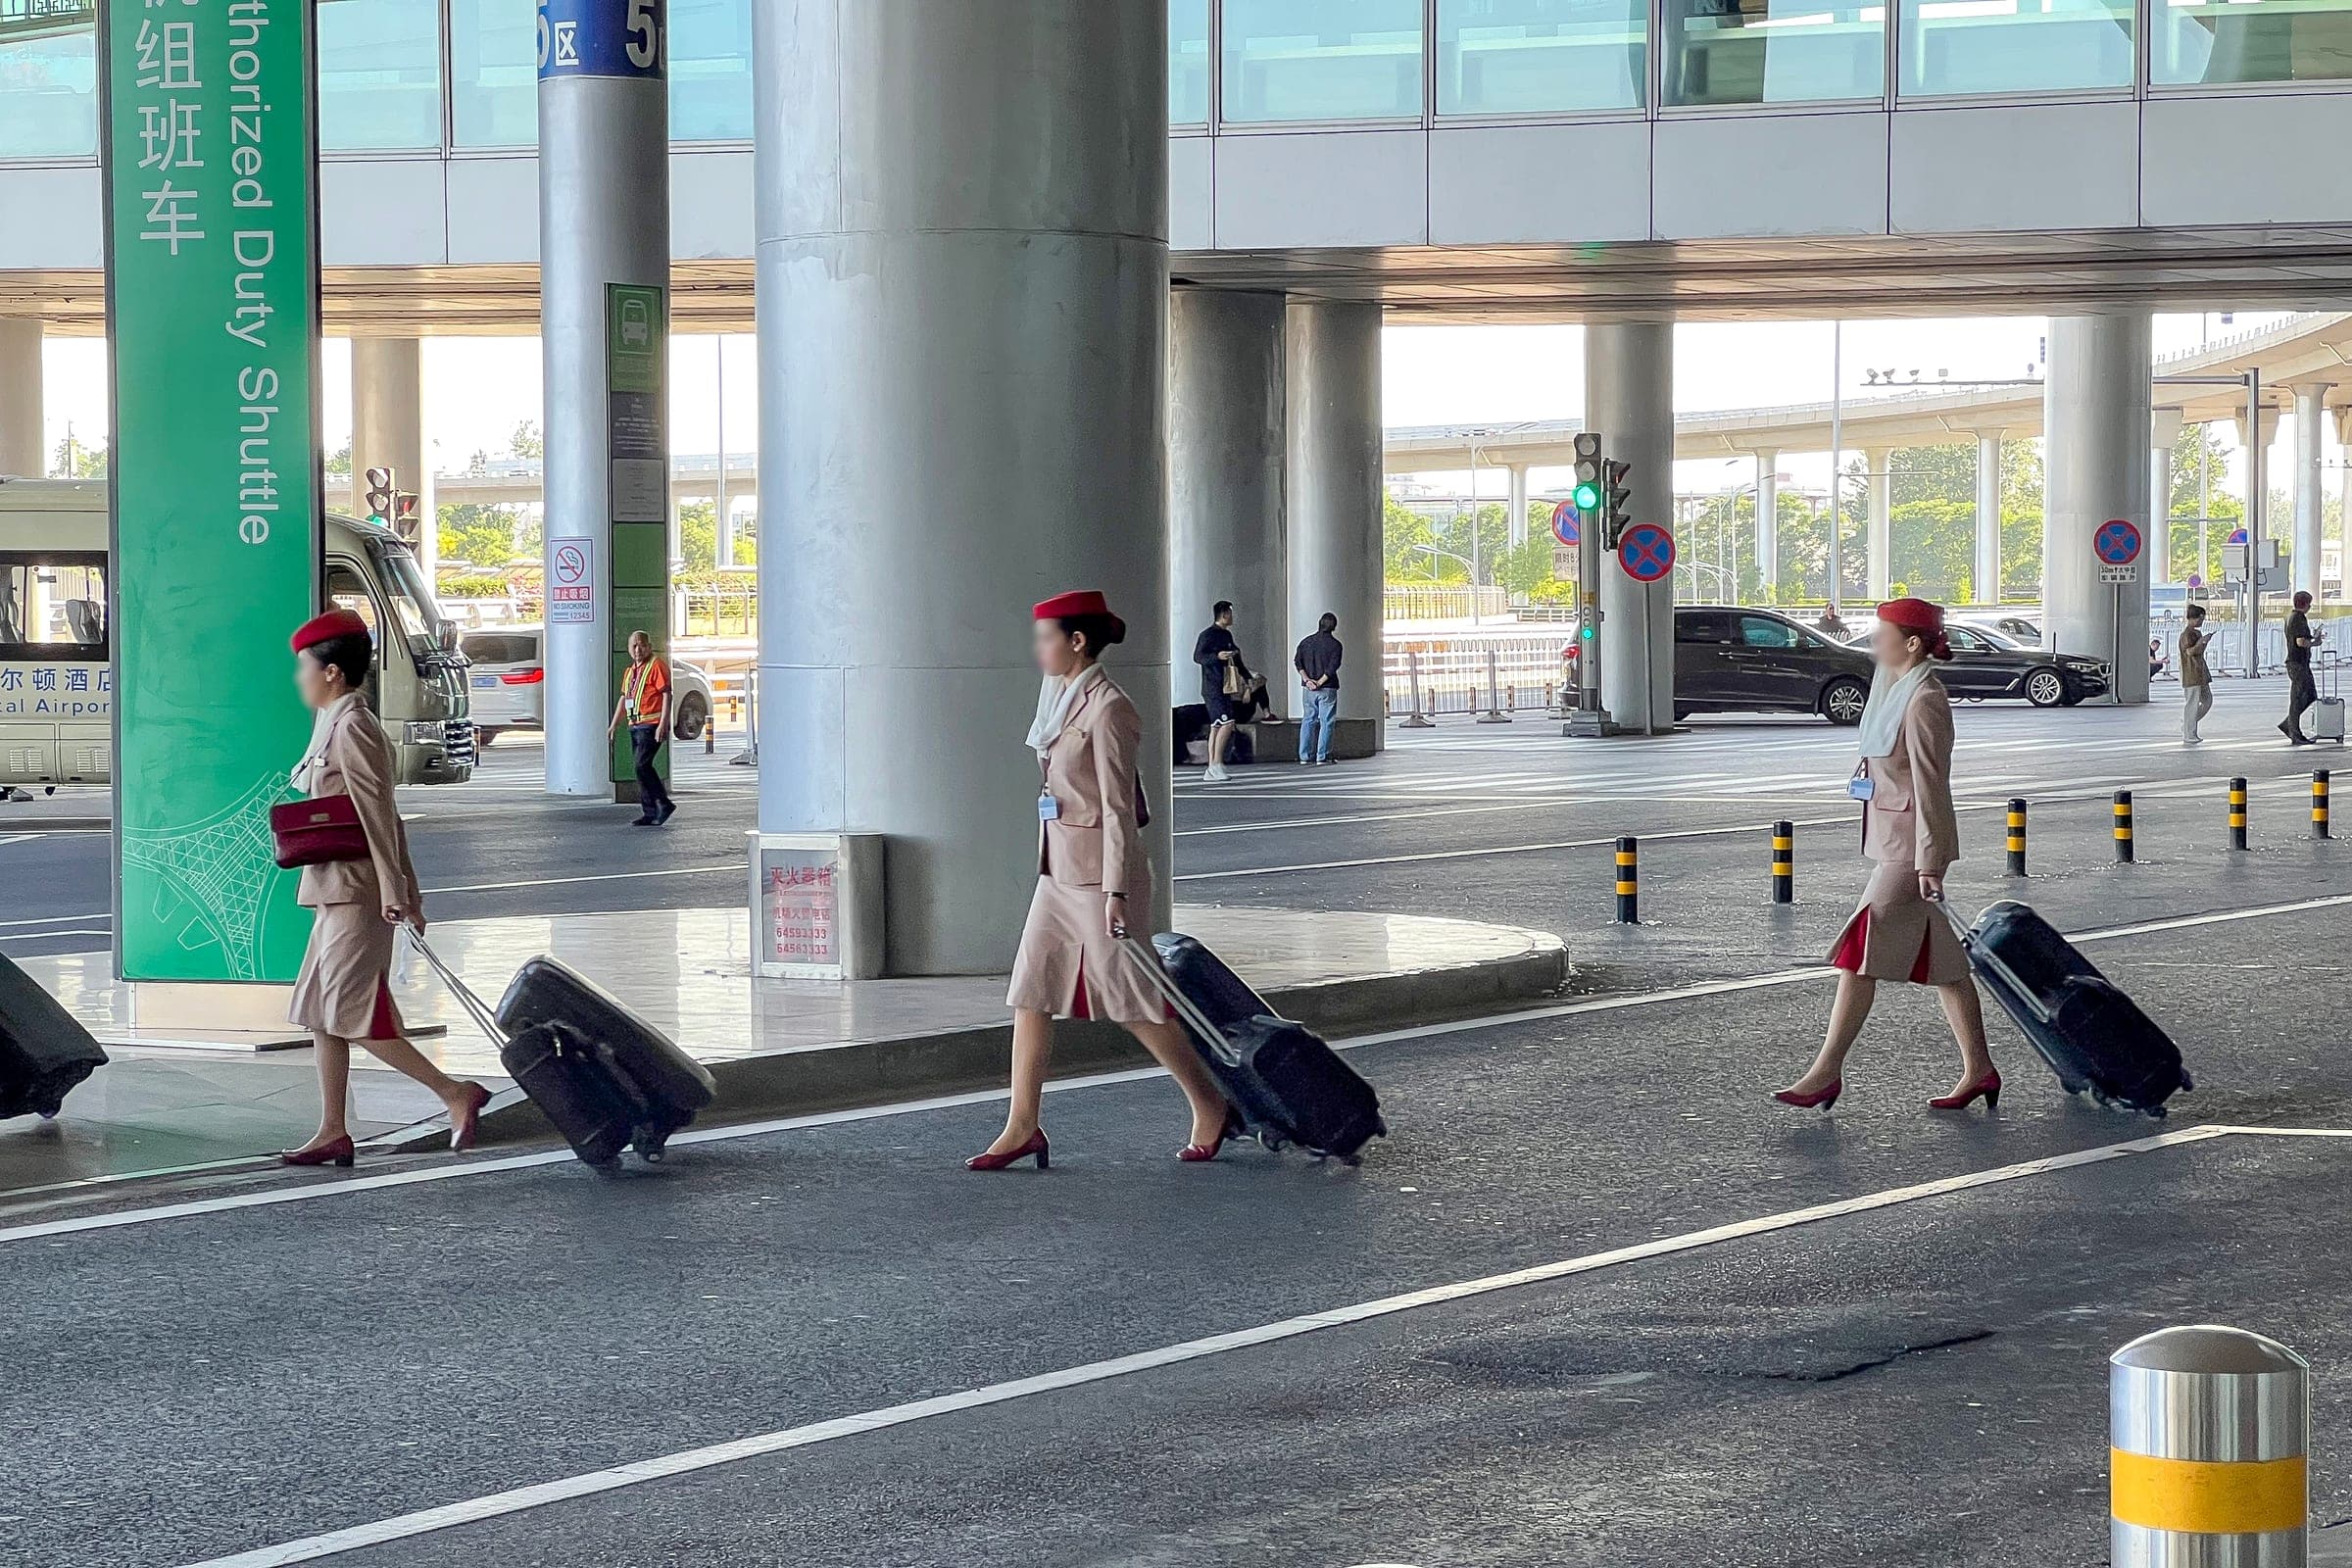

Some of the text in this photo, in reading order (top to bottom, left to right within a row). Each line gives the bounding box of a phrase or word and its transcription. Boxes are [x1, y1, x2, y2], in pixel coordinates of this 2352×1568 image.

[134, 0, 204, 255] 组班车
[225, 231, 274, 348] Duty
[238, 367, 279, 545] Shuttle
[570, 611, 590, 619] 12345
[770, 866, 831, 886] 灭火器箱
[776, 927, 827, 939] 64593333
